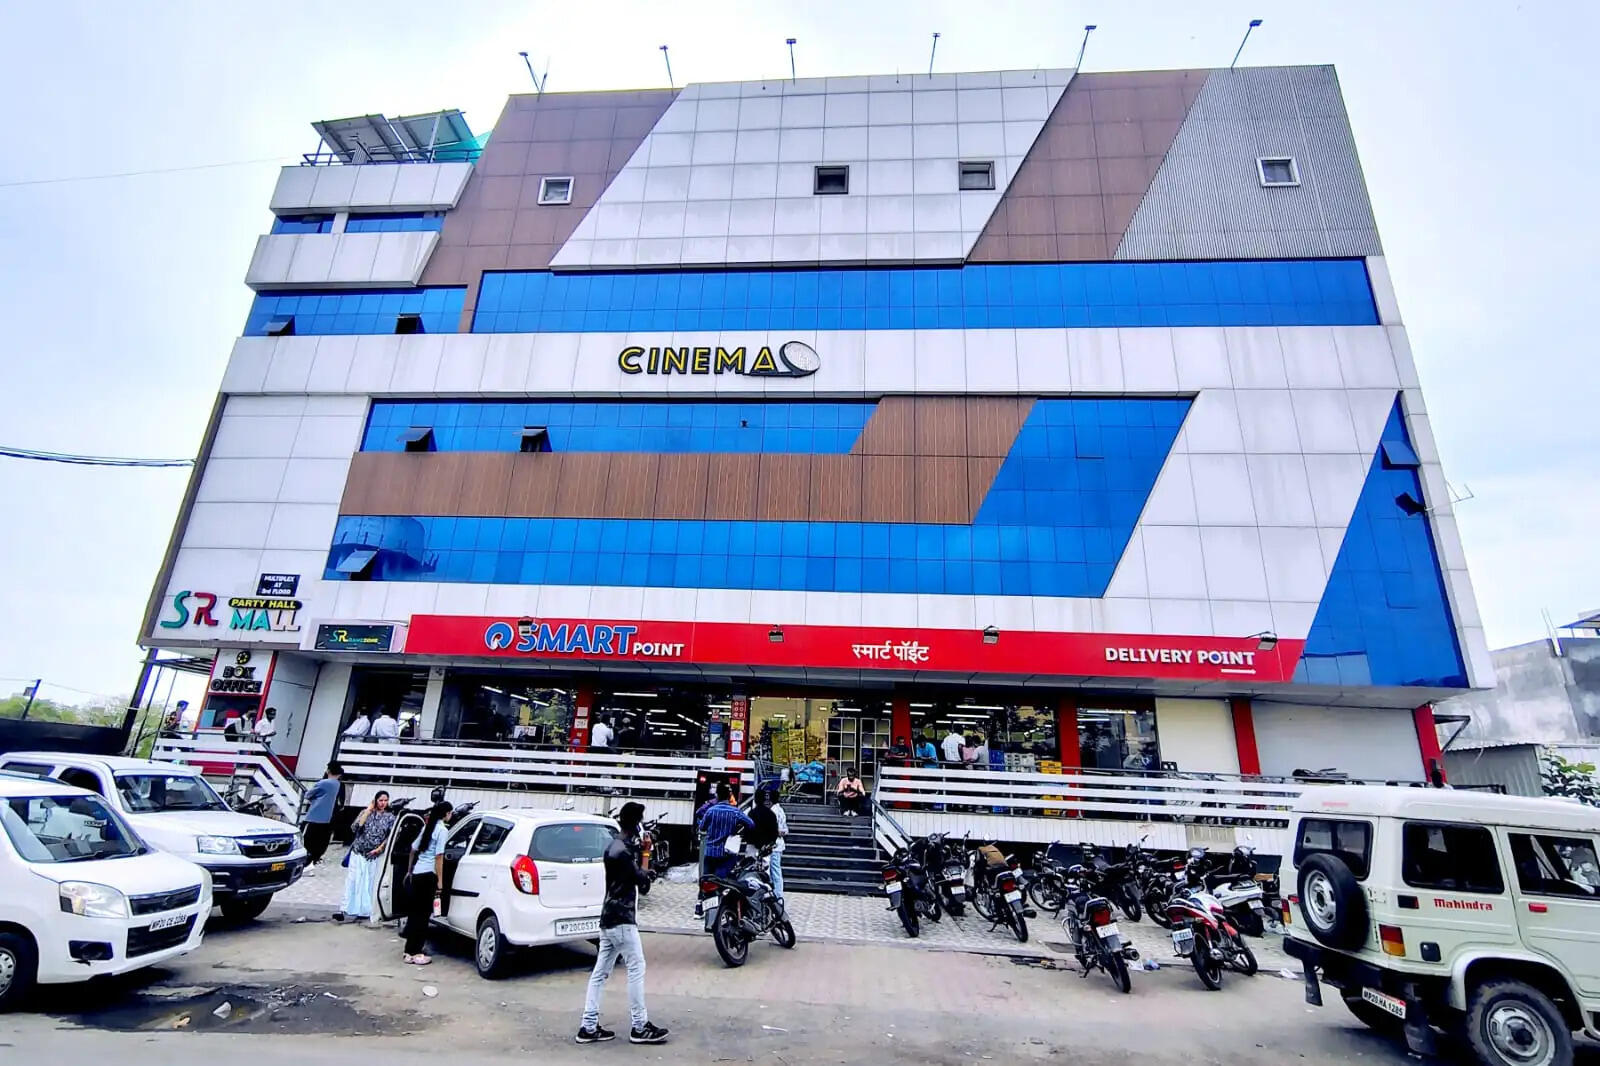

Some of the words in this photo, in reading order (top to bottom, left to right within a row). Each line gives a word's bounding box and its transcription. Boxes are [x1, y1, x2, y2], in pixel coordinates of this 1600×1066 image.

[618, 346, 778, 376] CINEMA
[160, 590, 219, 628] SR
[229, 608, 301, 631] MALL
[231, 599, 265, 608] PARTY
[269, 600, 296, 609] HALL
[516, 621, 637, 655] SMART
[632, 642, 684, 657] POINT
[851, 640, 892, 660] स्मार्ट
[1105, 648, 1192, 664] DELIVERY
[1197, 650, 1256, 666] POINT
[223, 665, 256, 680] BOX
[211, 679, 263, 693] OFFICE
[1434, 898, 1493, 911] Mahindra
